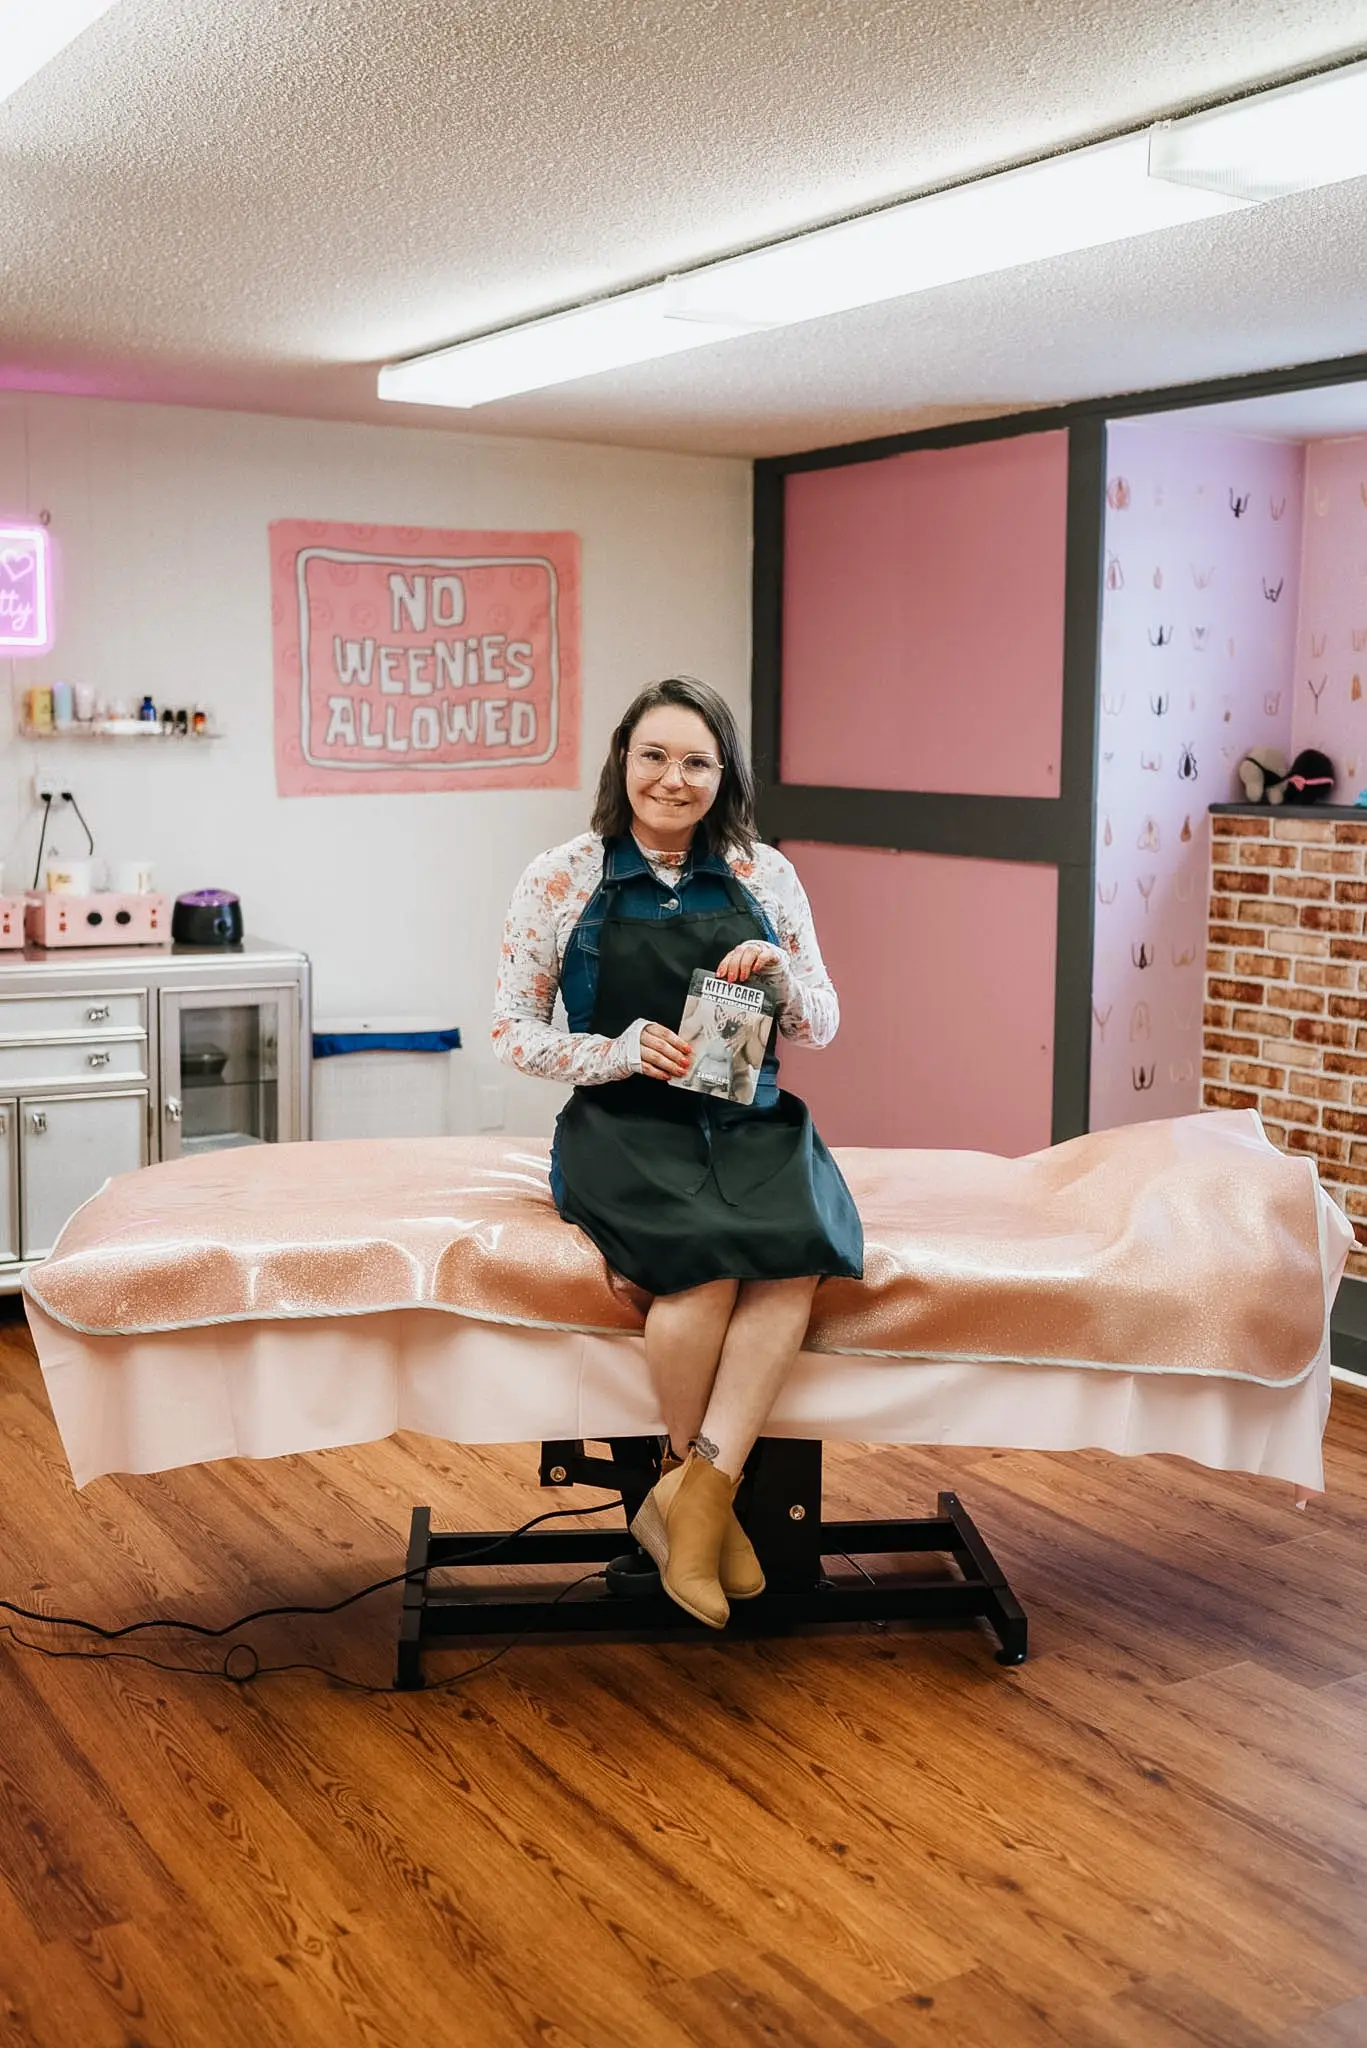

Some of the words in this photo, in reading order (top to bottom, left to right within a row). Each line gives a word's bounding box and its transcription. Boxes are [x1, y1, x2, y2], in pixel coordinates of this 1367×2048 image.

[388, 573, 466, 632] NO
[325, 696, 537, 752] ALLOWED
[704, 979, 734, 996] KITTY
[734, 986, 761, 1004] CARE
